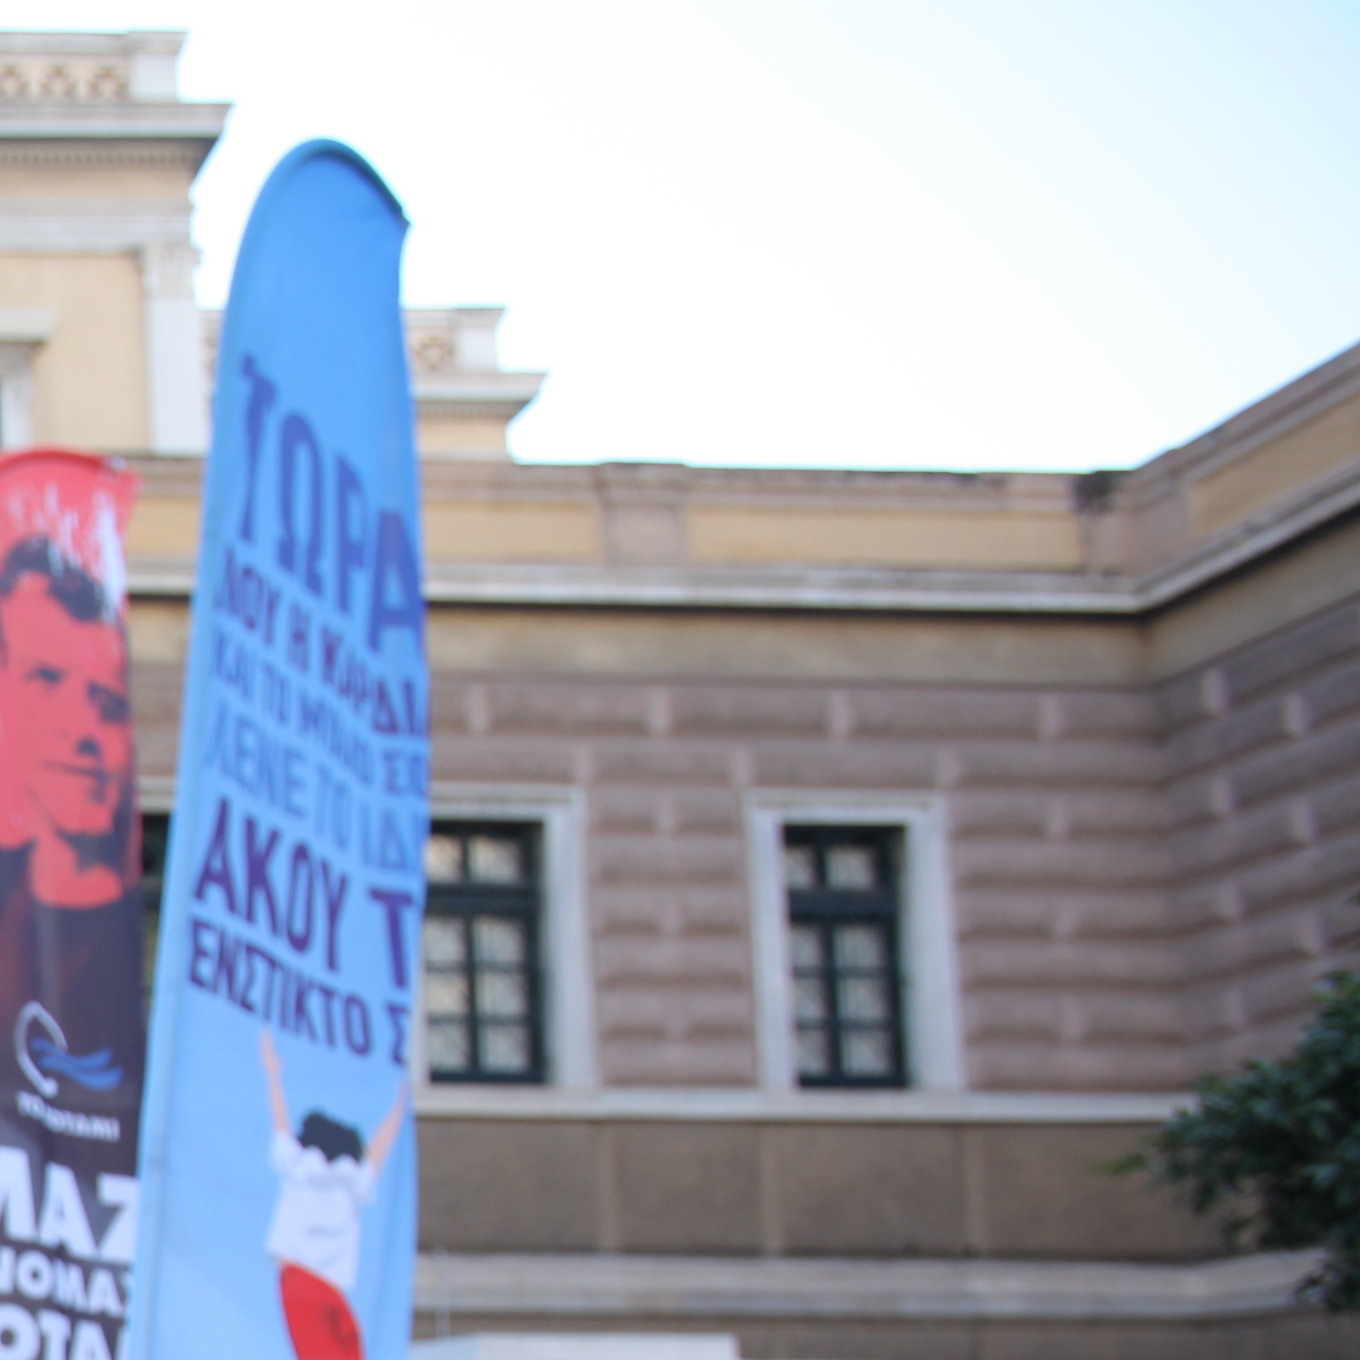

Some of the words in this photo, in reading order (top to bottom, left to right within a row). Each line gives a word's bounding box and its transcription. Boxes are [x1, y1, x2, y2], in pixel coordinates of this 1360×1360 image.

[237, 352, 427, 654] ΤΩΡΑ
[321, 622, 421, 735] ΚΑΡΔΙ
[194, 797, 349, 973] ΑΚΟΥ
[367, 885, 414, 990] Τ
[188, 916, 373, 1059] ΕΝΣΤΙΚΤΟ
[385, 1002, 410, 1067] Σ
